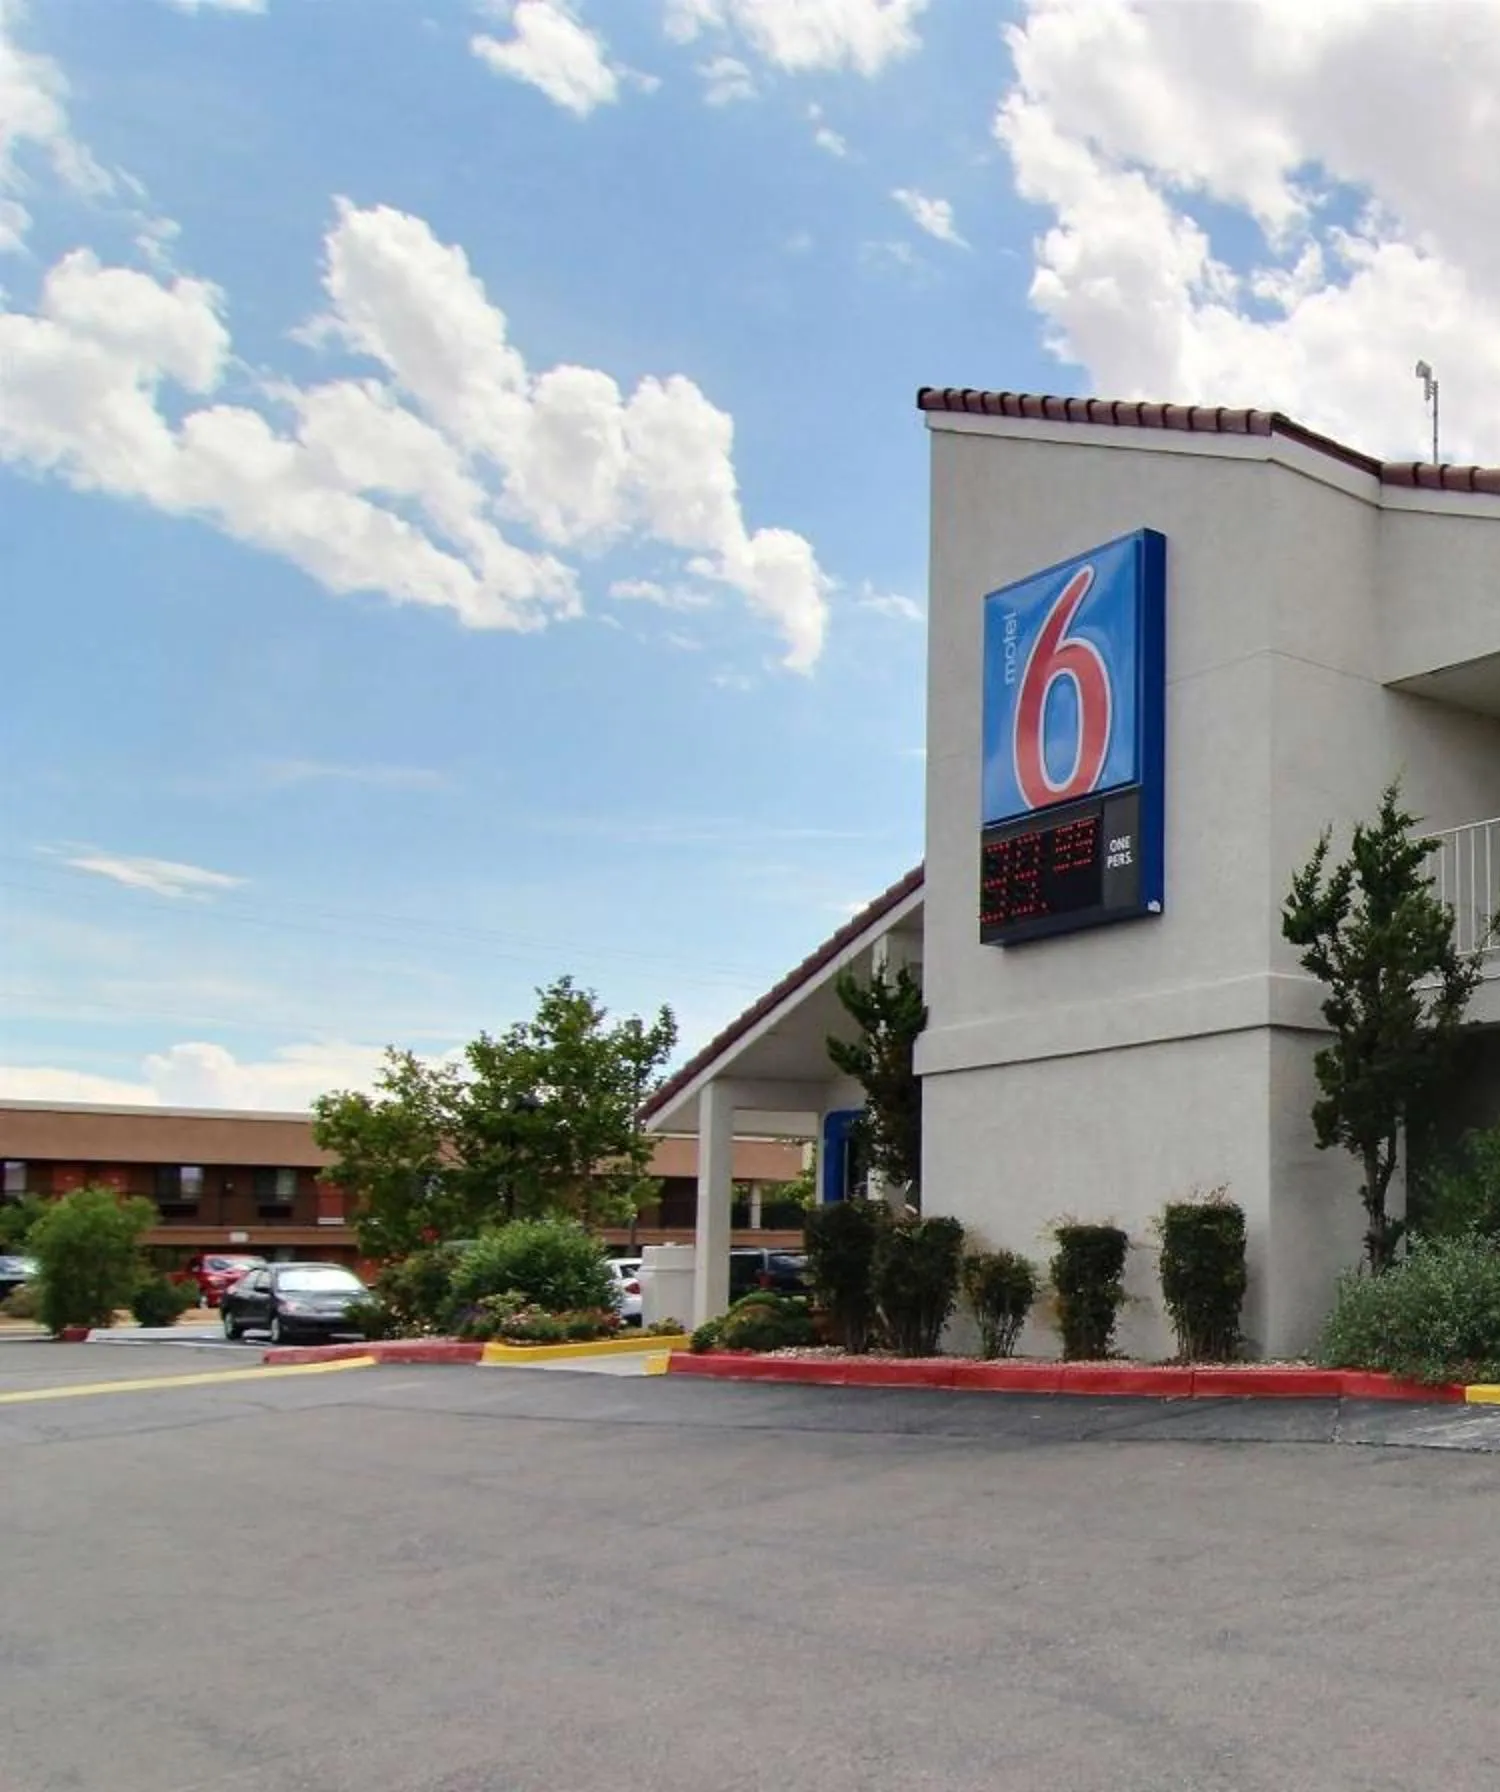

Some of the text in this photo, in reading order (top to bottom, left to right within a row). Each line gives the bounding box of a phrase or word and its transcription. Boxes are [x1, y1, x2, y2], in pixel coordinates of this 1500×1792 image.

[1003, 565, 1112, 809] motel 6
[1109, 835, 1131, 853] ONE
